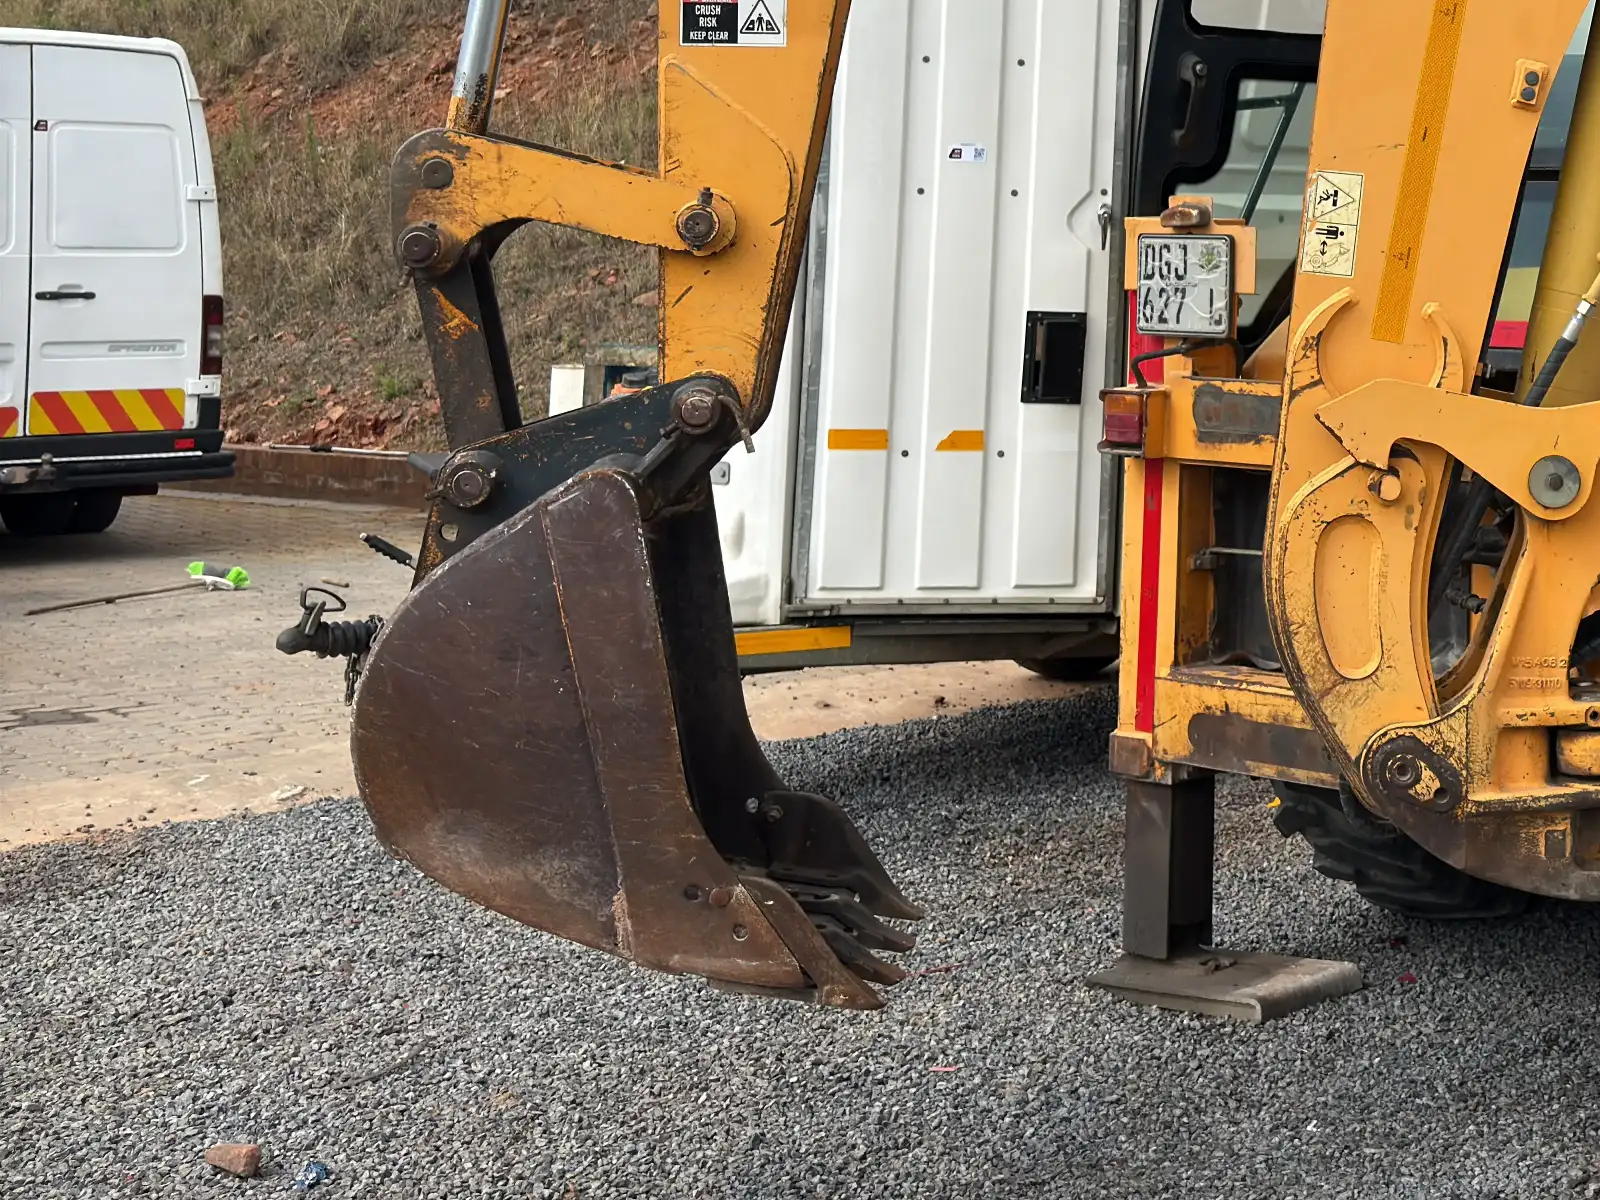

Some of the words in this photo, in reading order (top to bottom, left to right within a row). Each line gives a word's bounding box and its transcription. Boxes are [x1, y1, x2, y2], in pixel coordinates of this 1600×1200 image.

[695, 4, 721, 15] CRUSH
[699, 17, 717, 27] RISK
[690, 31, 706, 40] KEEP
[708, 31, 729, 40] CLEAR
[1143, 243, 1188, 281] DGJ
[1142, 286, 1187, 324] 627
